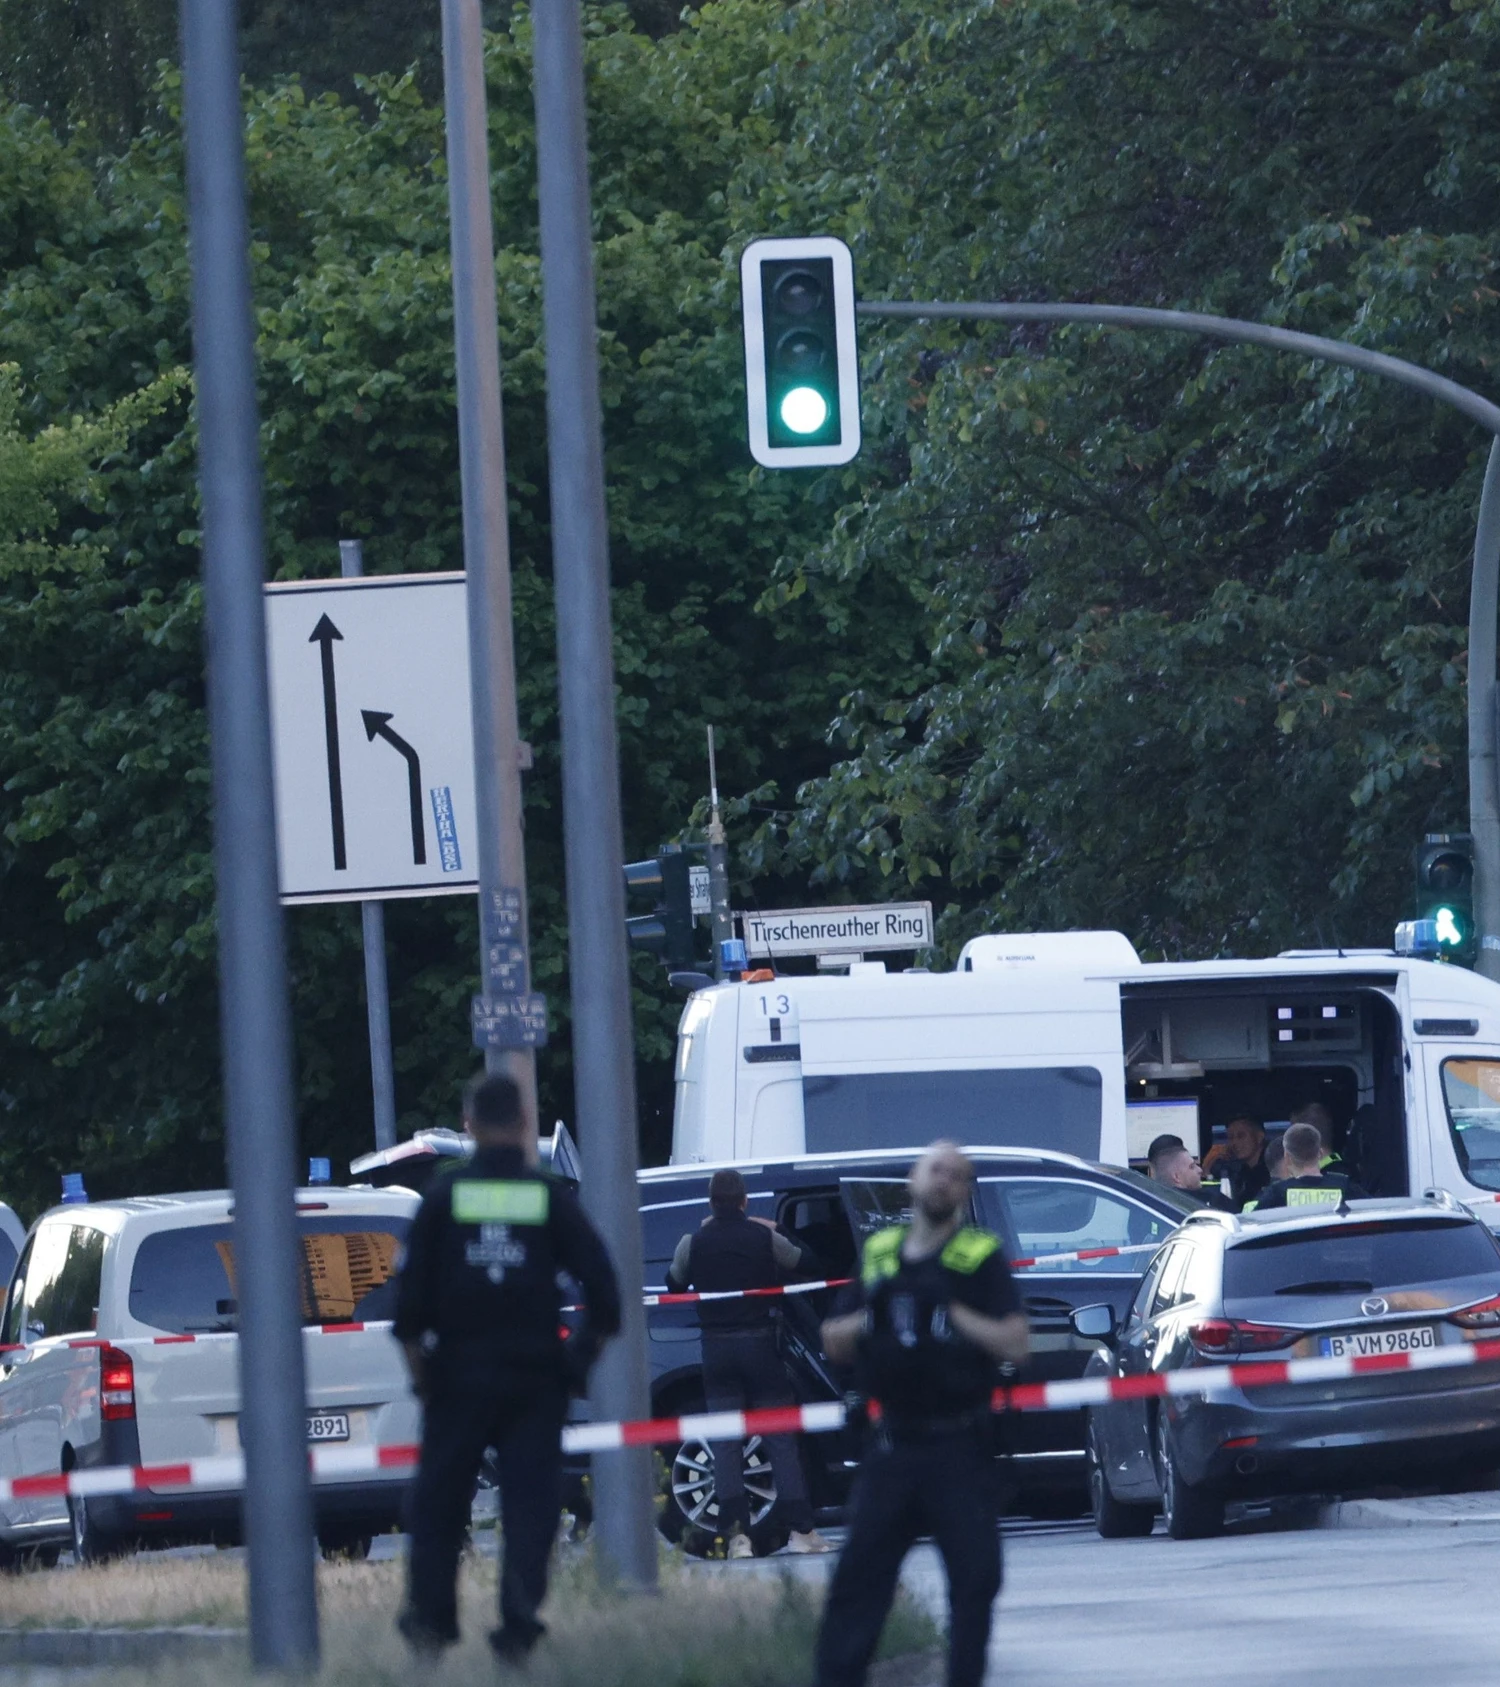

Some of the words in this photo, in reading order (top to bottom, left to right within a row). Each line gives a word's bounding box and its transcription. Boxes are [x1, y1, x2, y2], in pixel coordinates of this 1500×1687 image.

[750, 916, 880, 942] Tirschenreuther
[885, 914, 923, 938] Ring
[758, 994, 790, 1015] 13
[1332, 1339, 1345, 1357] B
[1356, 1335, 1383, 1355] VM
[1386, 1328, 1433, 1352] 9860
